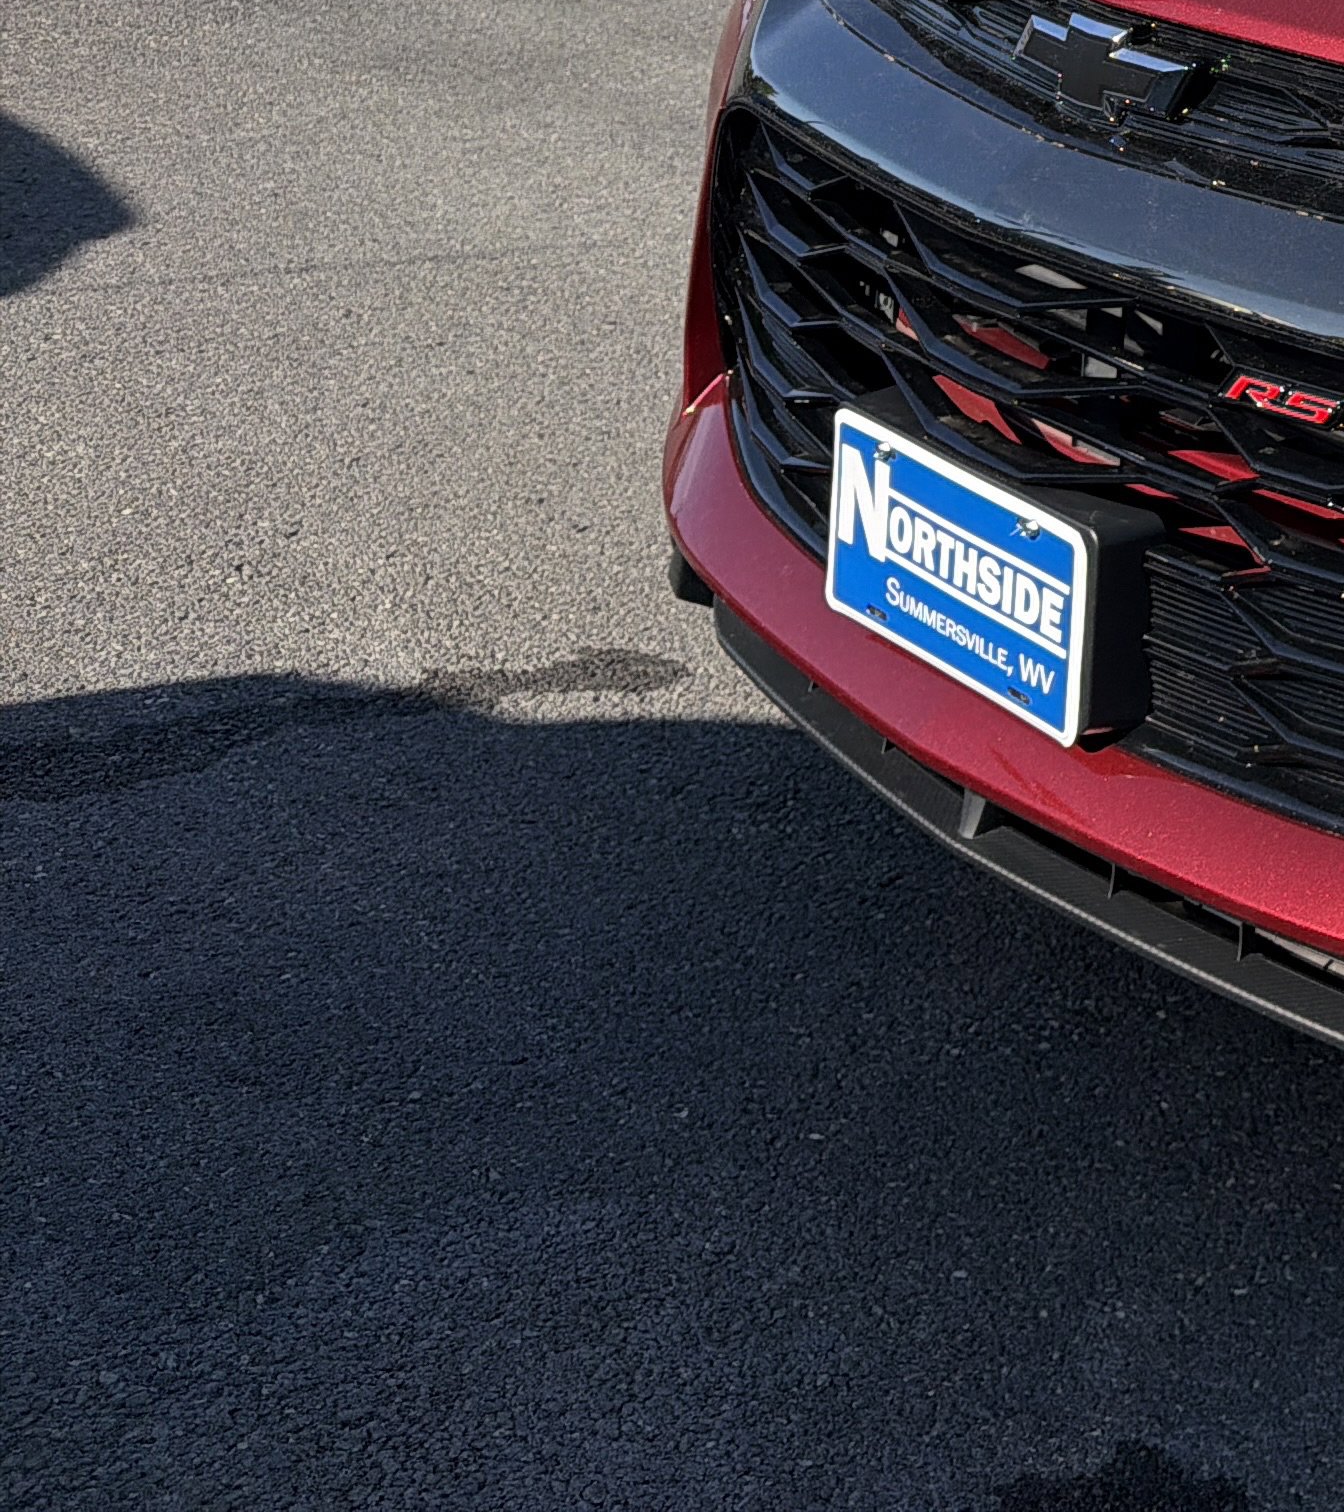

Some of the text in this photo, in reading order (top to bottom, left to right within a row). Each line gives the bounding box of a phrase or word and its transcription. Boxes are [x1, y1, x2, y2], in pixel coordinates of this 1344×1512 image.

[1225, 375, 1338, 424] RS
[838, 443, 1065, 644] NORTHSIDE
[885, 576, 1055, 694] SUMMERSVILLE, WV
